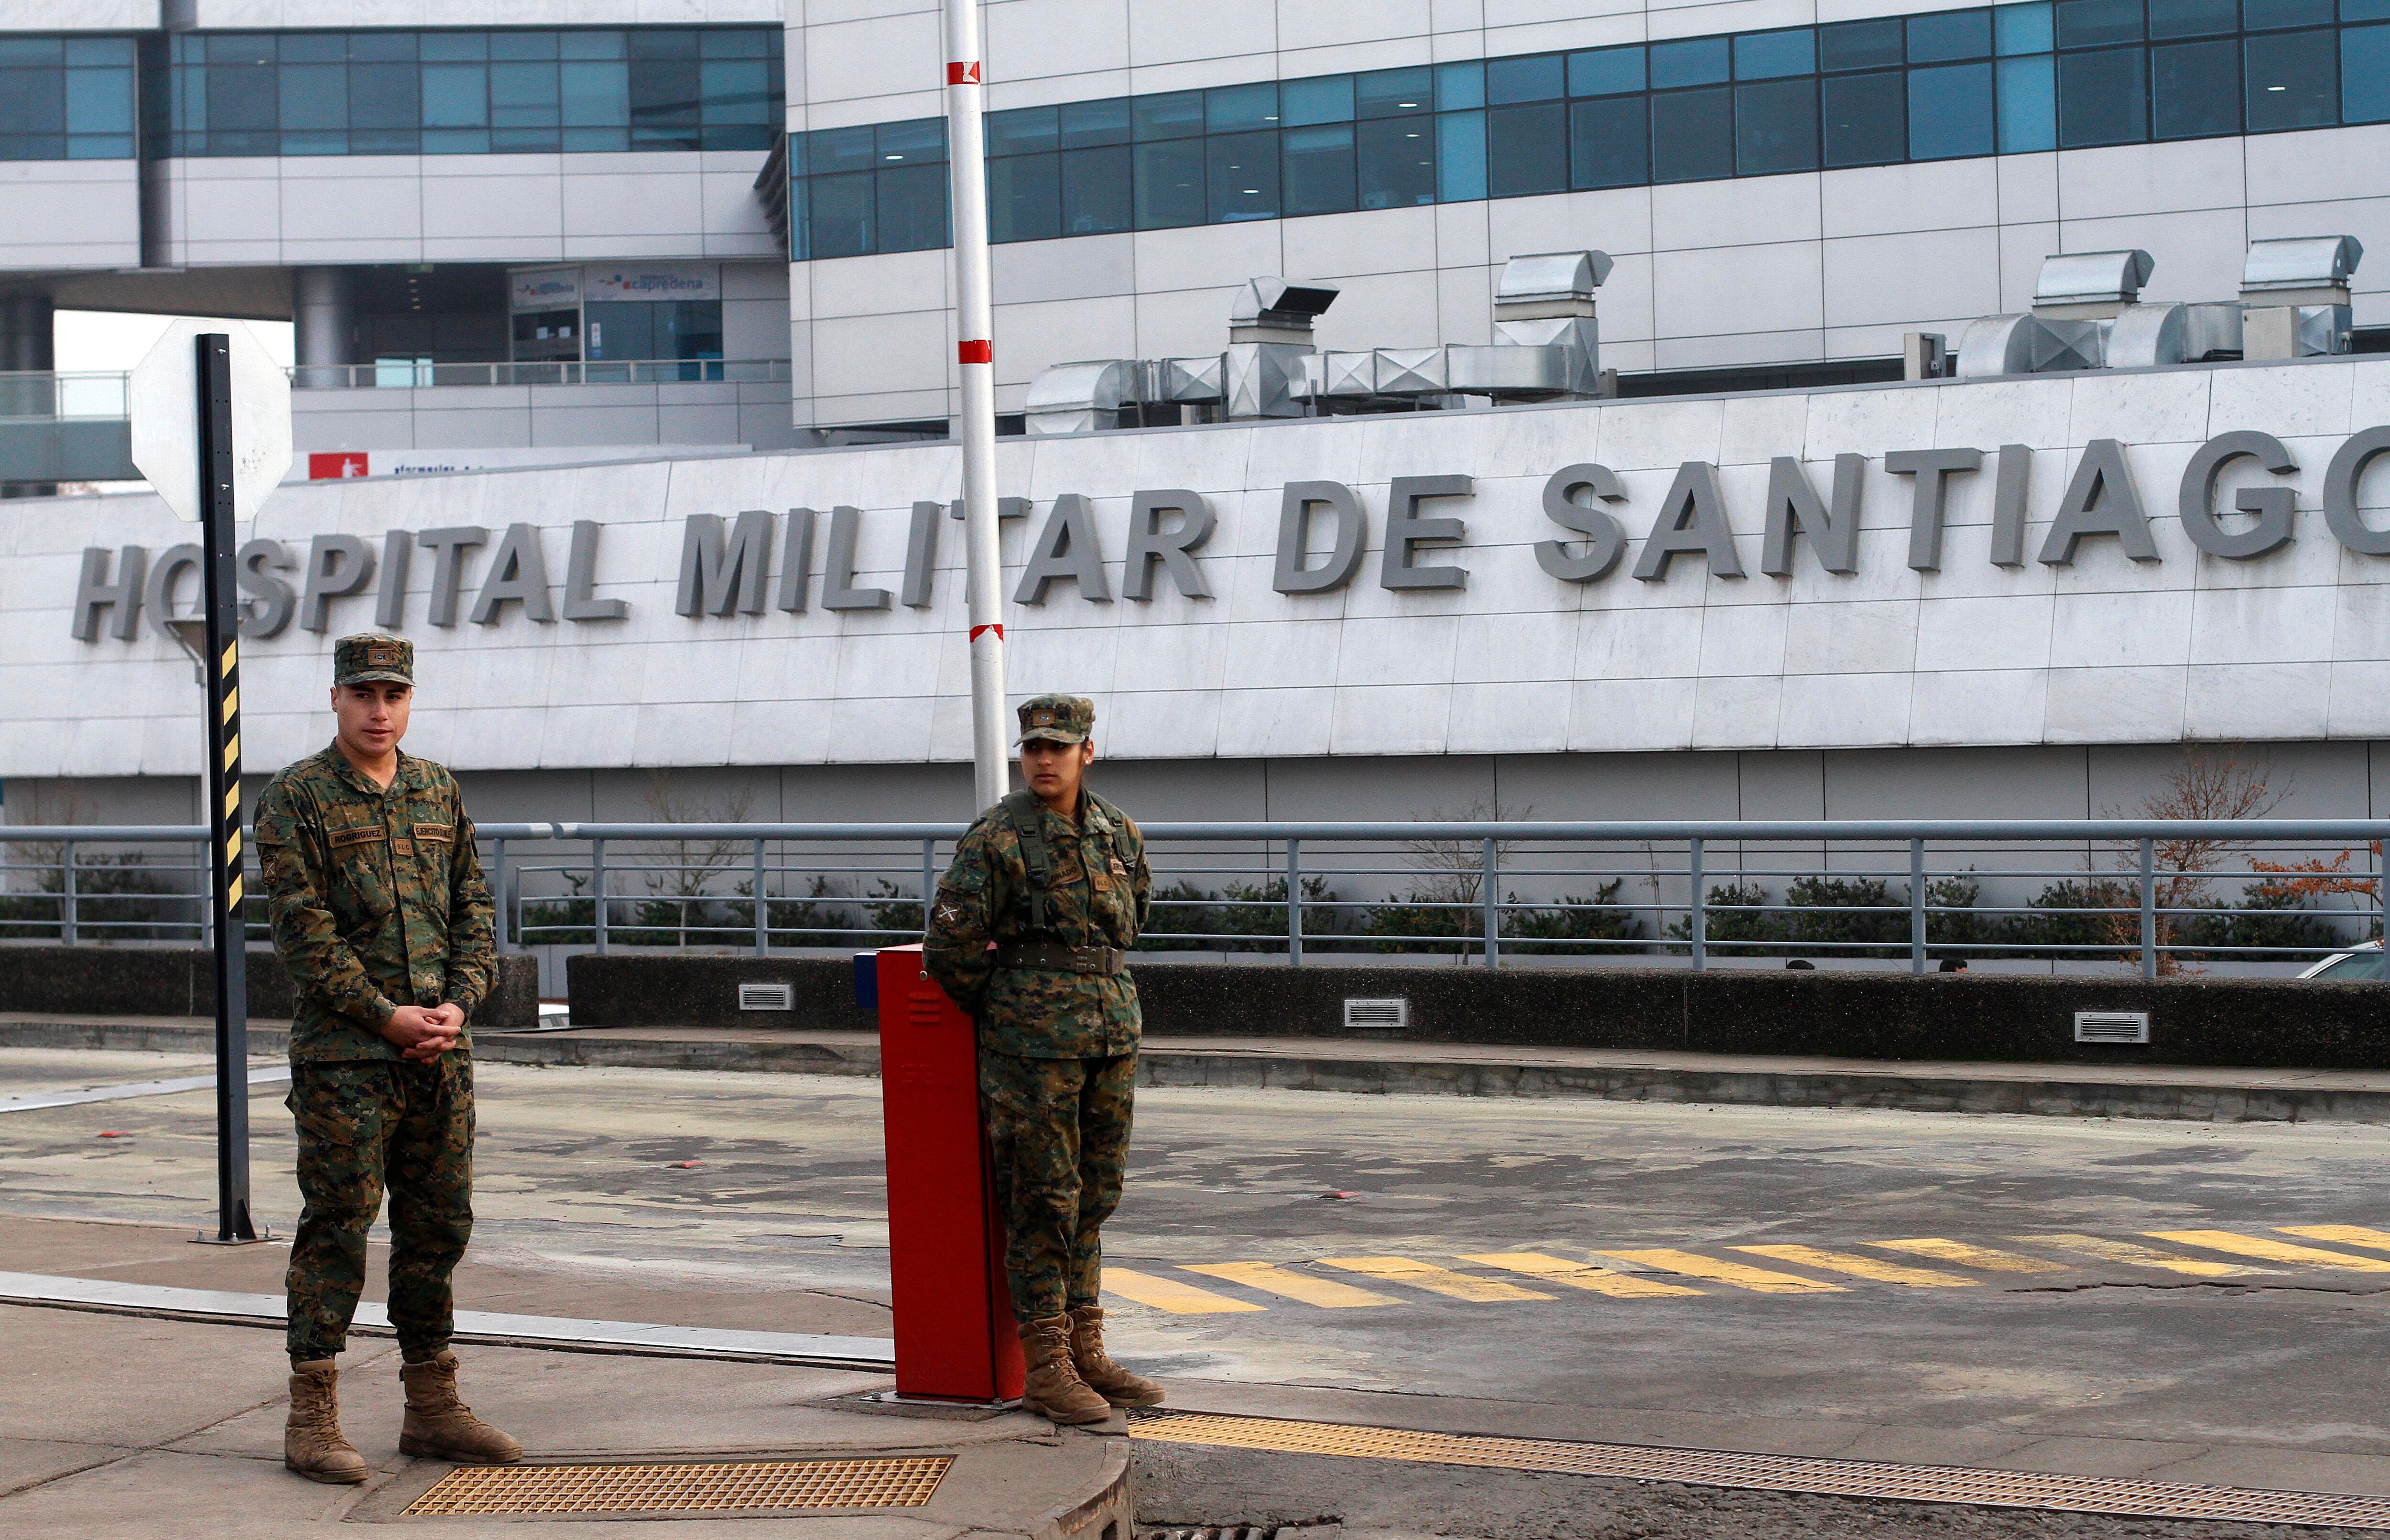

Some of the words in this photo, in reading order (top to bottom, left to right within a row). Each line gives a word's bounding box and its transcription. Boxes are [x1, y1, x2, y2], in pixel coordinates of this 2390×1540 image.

[71, 520, 632, 641] HOSPITAL
[675, 488, 1216, 617] MILIAR
[1272, 474, 1473, 595] DE
[334, 830, 382, 844] RODRIGUEZ
[415, 827, 439, 835] EJERCITO
